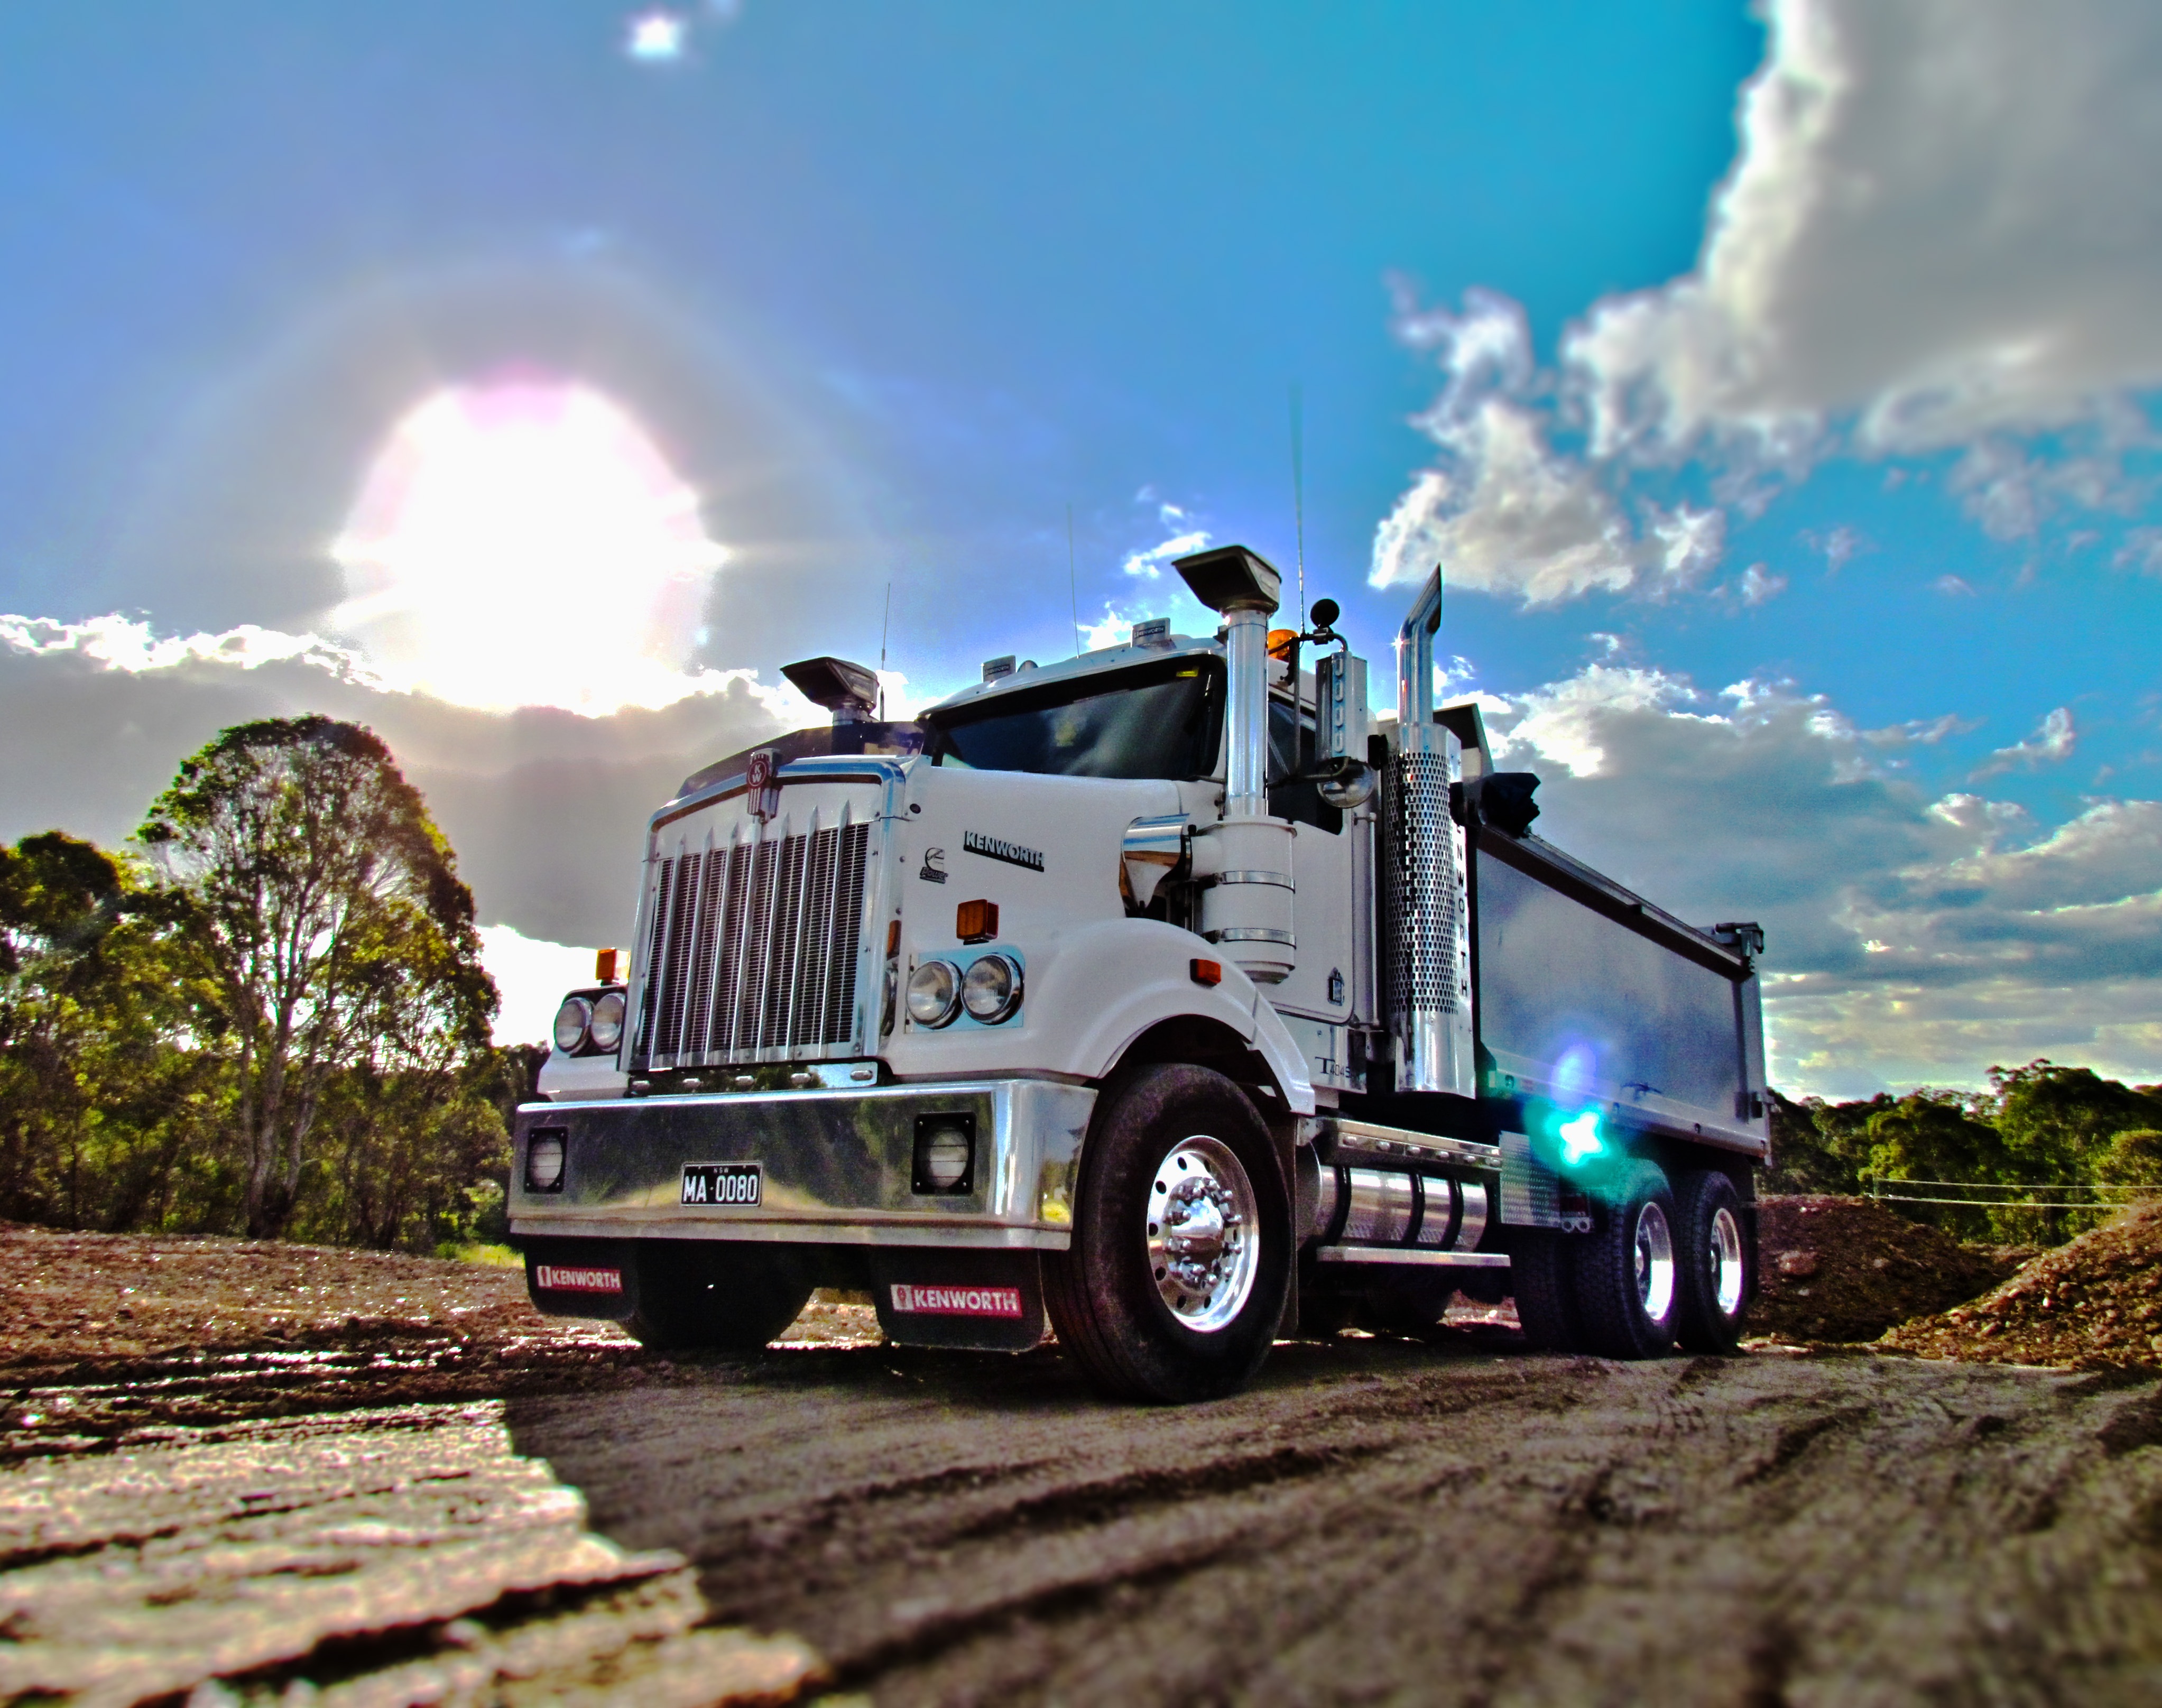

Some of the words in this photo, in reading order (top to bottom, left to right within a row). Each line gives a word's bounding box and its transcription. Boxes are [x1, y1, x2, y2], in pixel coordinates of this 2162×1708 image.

[964, 830, 1045, 867] KENWORTH
[1456, 825, 1468, 997] NWORTH
[682, 1175, 707, 1203] MA
[715, 1174, 758, 1203] 0080
[551, 1269, 621, 1288] KENWORTH
[914, 1289, 1019, 1312] KENWORTH
